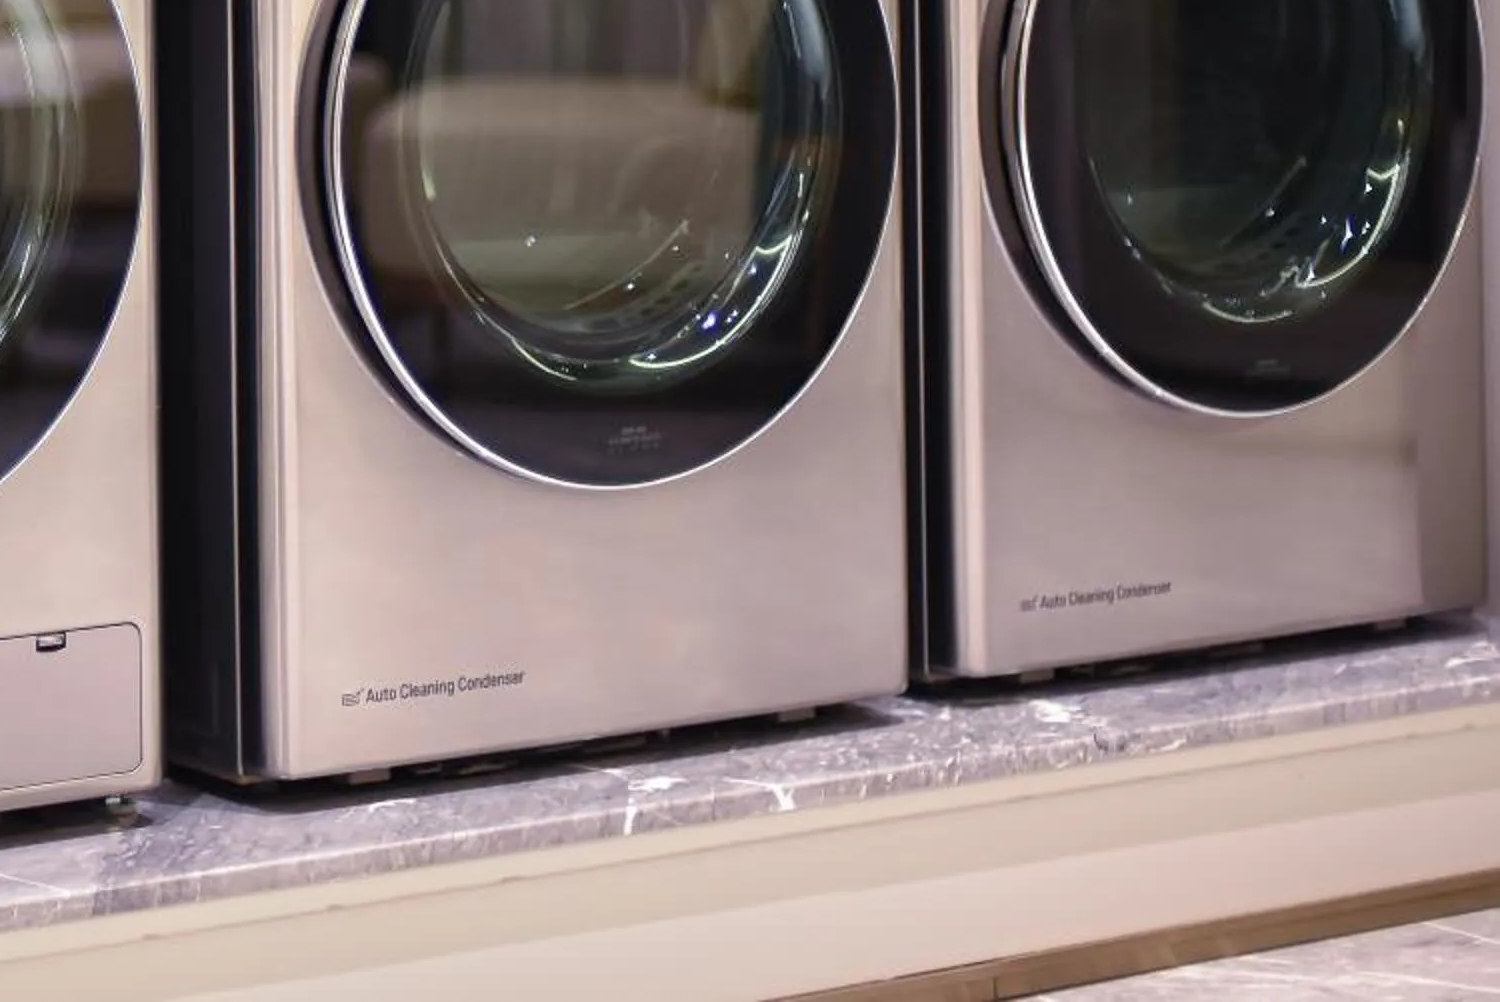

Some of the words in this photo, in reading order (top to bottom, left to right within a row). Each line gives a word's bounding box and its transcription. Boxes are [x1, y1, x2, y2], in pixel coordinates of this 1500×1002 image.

[366, 689, 397, 703] Auto
[399, 679, 455, 699] Cleaning
[457, 672, 525, 692] Condenser
